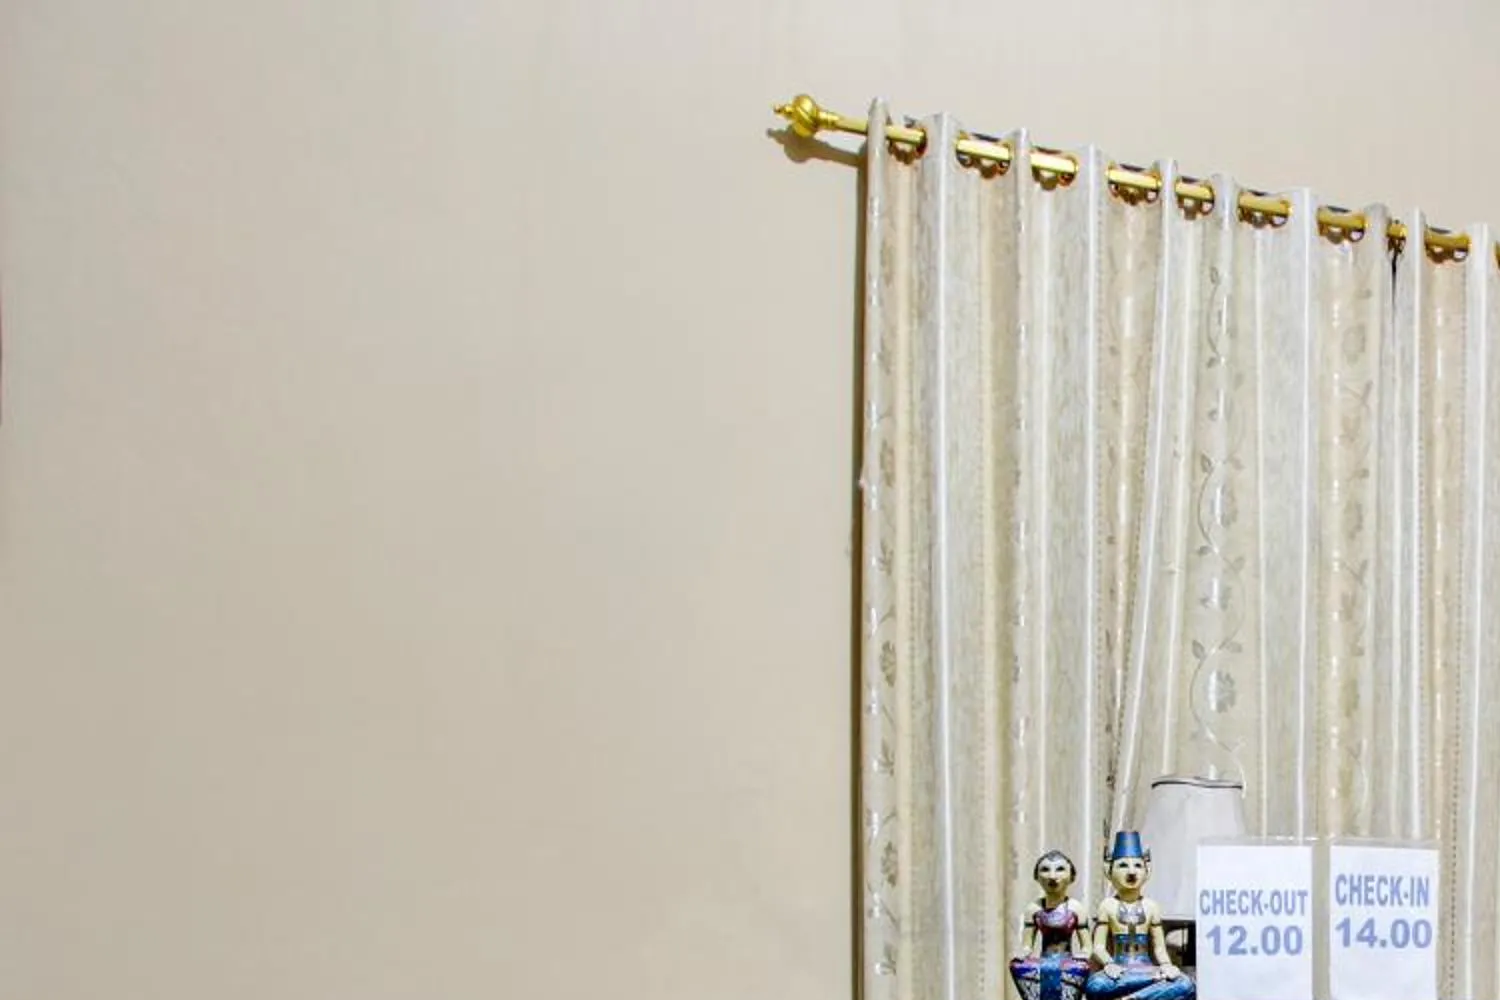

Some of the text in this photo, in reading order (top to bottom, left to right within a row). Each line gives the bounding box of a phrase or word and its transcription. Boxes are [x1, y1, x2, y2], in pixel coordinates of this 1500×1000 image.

[1199, 889, 1308, 916] CHECK-OUT
[1335, 874, 1430, 909] CHECK-IN
[1205, 925, 1303, 956] 12.00
[1335, 916, 1433, 949] 14.00
